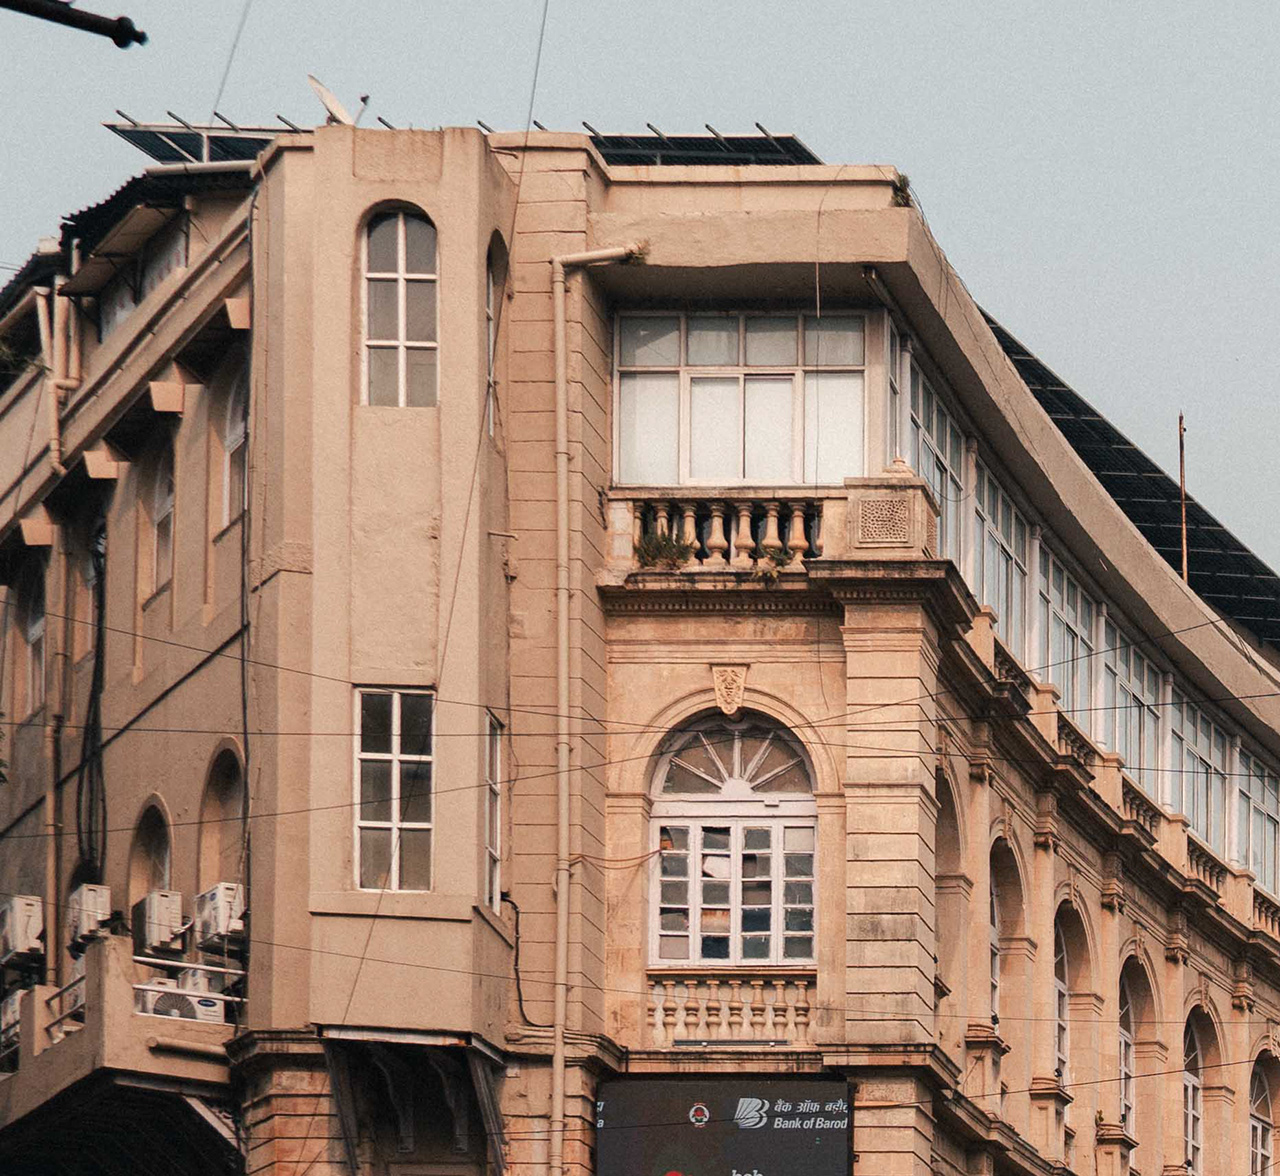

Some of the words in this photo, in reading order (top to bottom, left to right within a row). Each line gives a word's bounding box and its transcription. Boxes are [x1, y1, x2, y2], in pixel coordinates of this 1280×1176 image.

[774, 1117, 802, 1129] Bank
[803, 1117, 815, 1129] of
[815, 1117, 848, 1129] Barod
